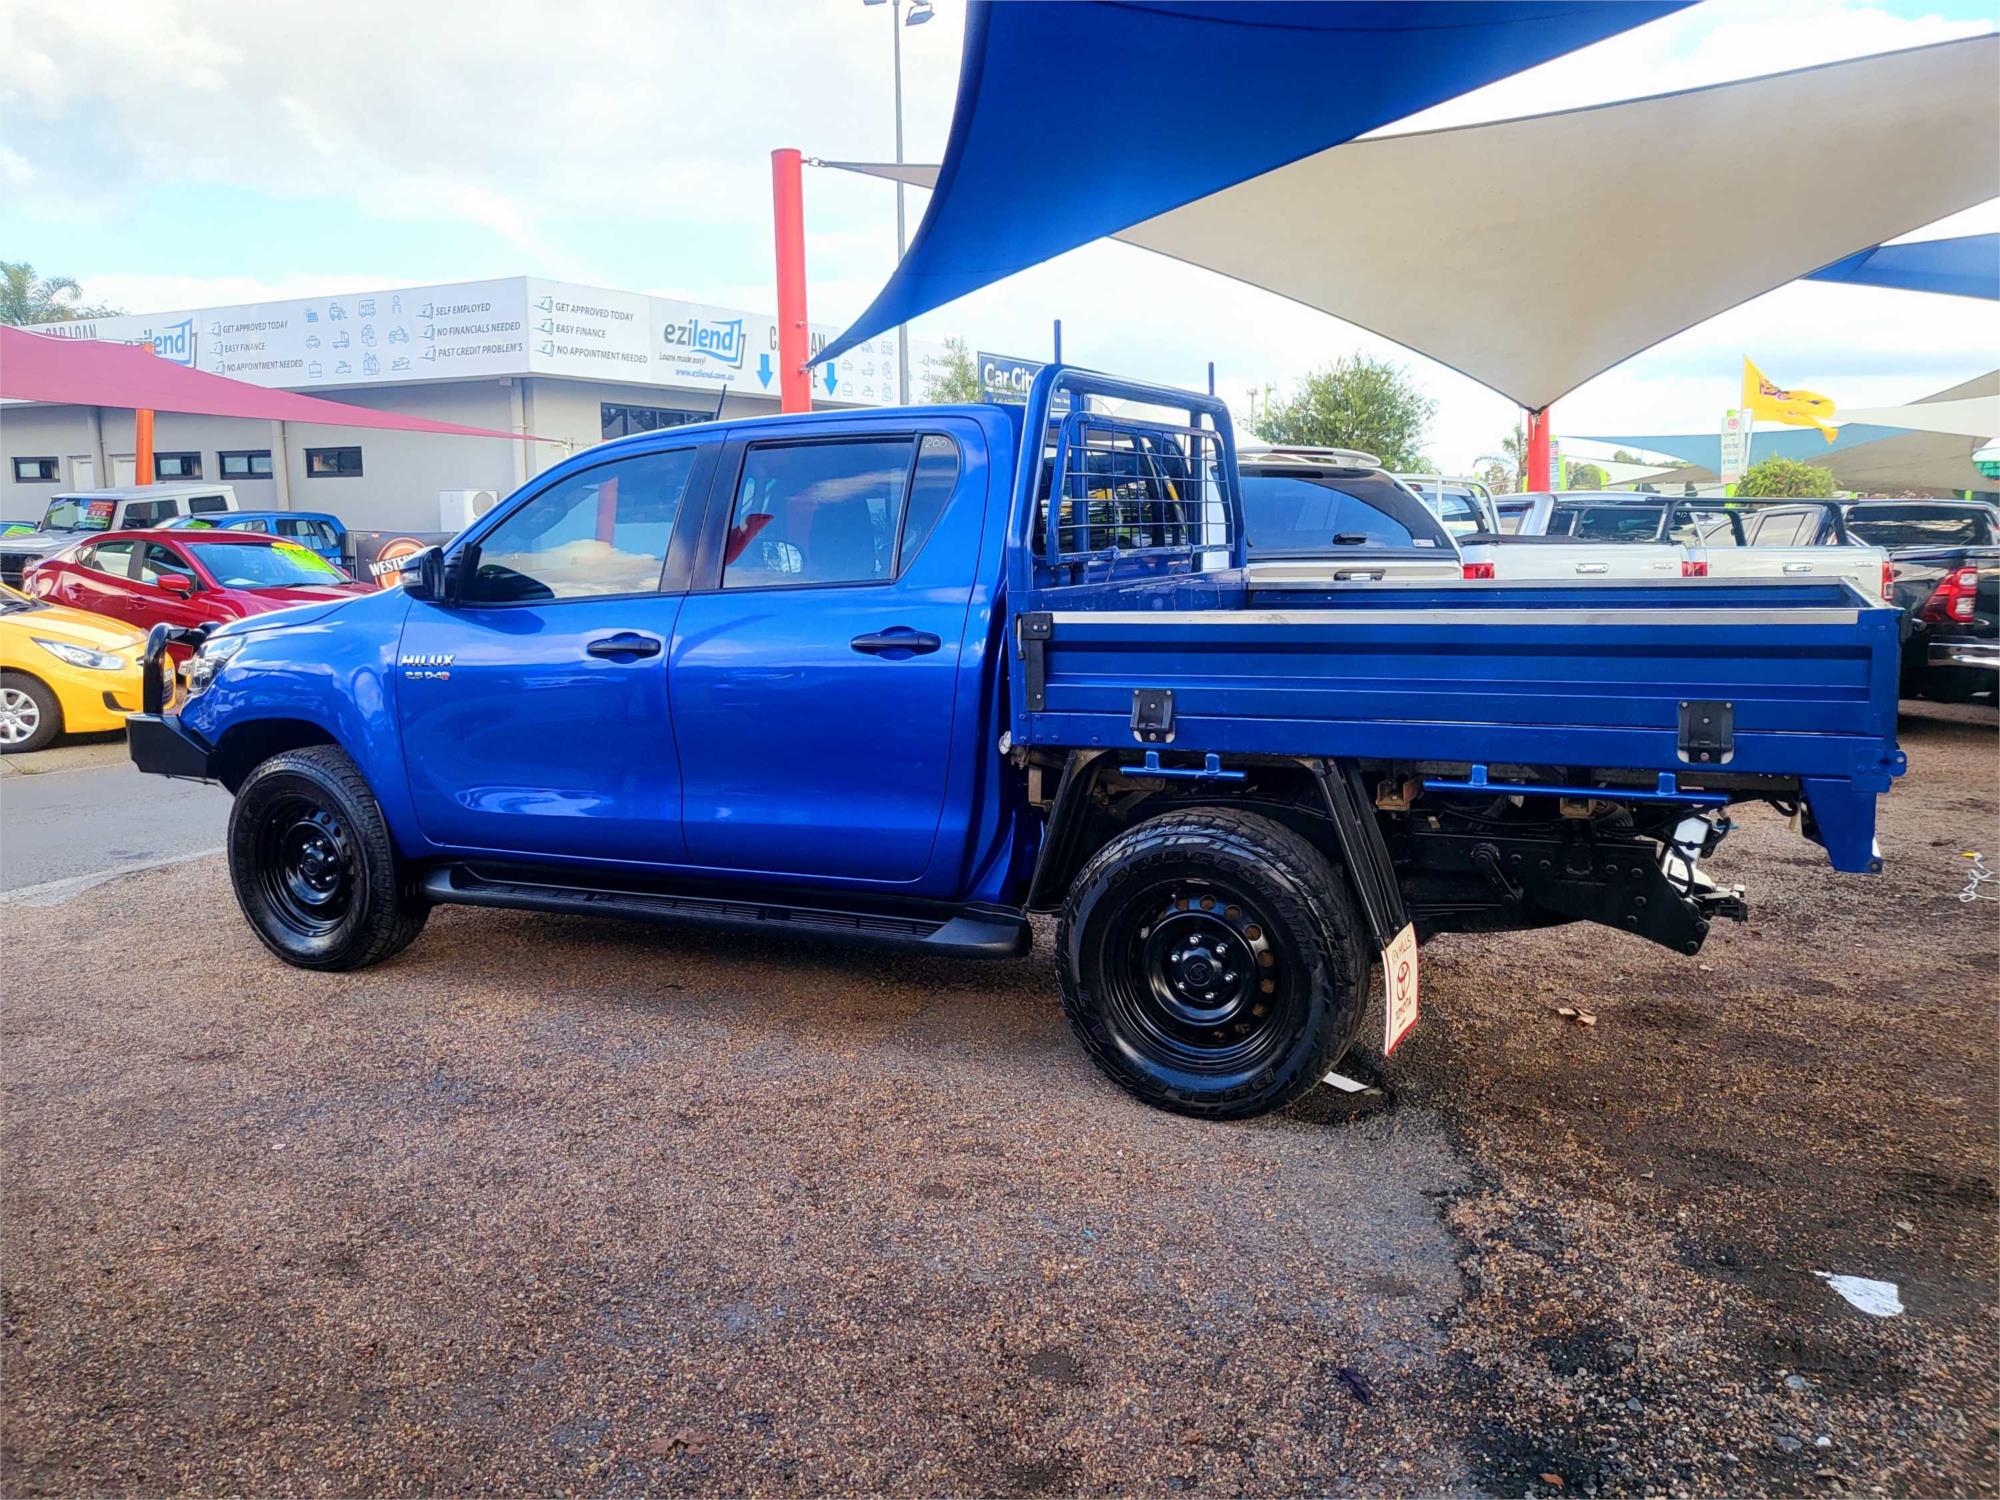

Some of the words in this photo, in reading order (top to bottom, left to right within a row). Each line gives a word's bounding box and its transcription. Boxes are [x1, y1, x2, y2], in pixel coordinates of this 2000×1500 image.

[436, 306, 451, 316] SELF
[452, 303, 491, 314] EMPLOYED
[555, 302, 570, 312] GET
[571, 305, 609, 319] APPROVED
[610, 310, 634, 321] TODAY
[223, 324, 234, 334] GET
[235, 322, 267, 333] APPROVED
[268, 320, 288, 330] TODAY
[437, 327, 447, 337] NO
[448, 324, 490, 336] FINANCIALS
[491, 321, 521, 332] NEEDED
[556, 324, 574, 334] EASY
[575, 327, 607, 339] FINANCE
[664, 319, 734, 352] ezilend
[225, 343, 240, 353] EASY
[240, 342, 265, 352] FINANCE
[438, 348, 455, 357] PAST
[456, 346, 481, 356] CREDIT
[557, 345, 568, 355] NO
[569, 347, 620, 360] APPOINTMENT
[621, 353, 648, 364] NEEDED
[227, 363, 236, 372] NO
[237, 361, 279, 371] APPOINTMENT
[280, 359, 303, 369] NEEDED
[984, 362, 1009, 388] Car
[401, 654, 456, 668] HILUX
